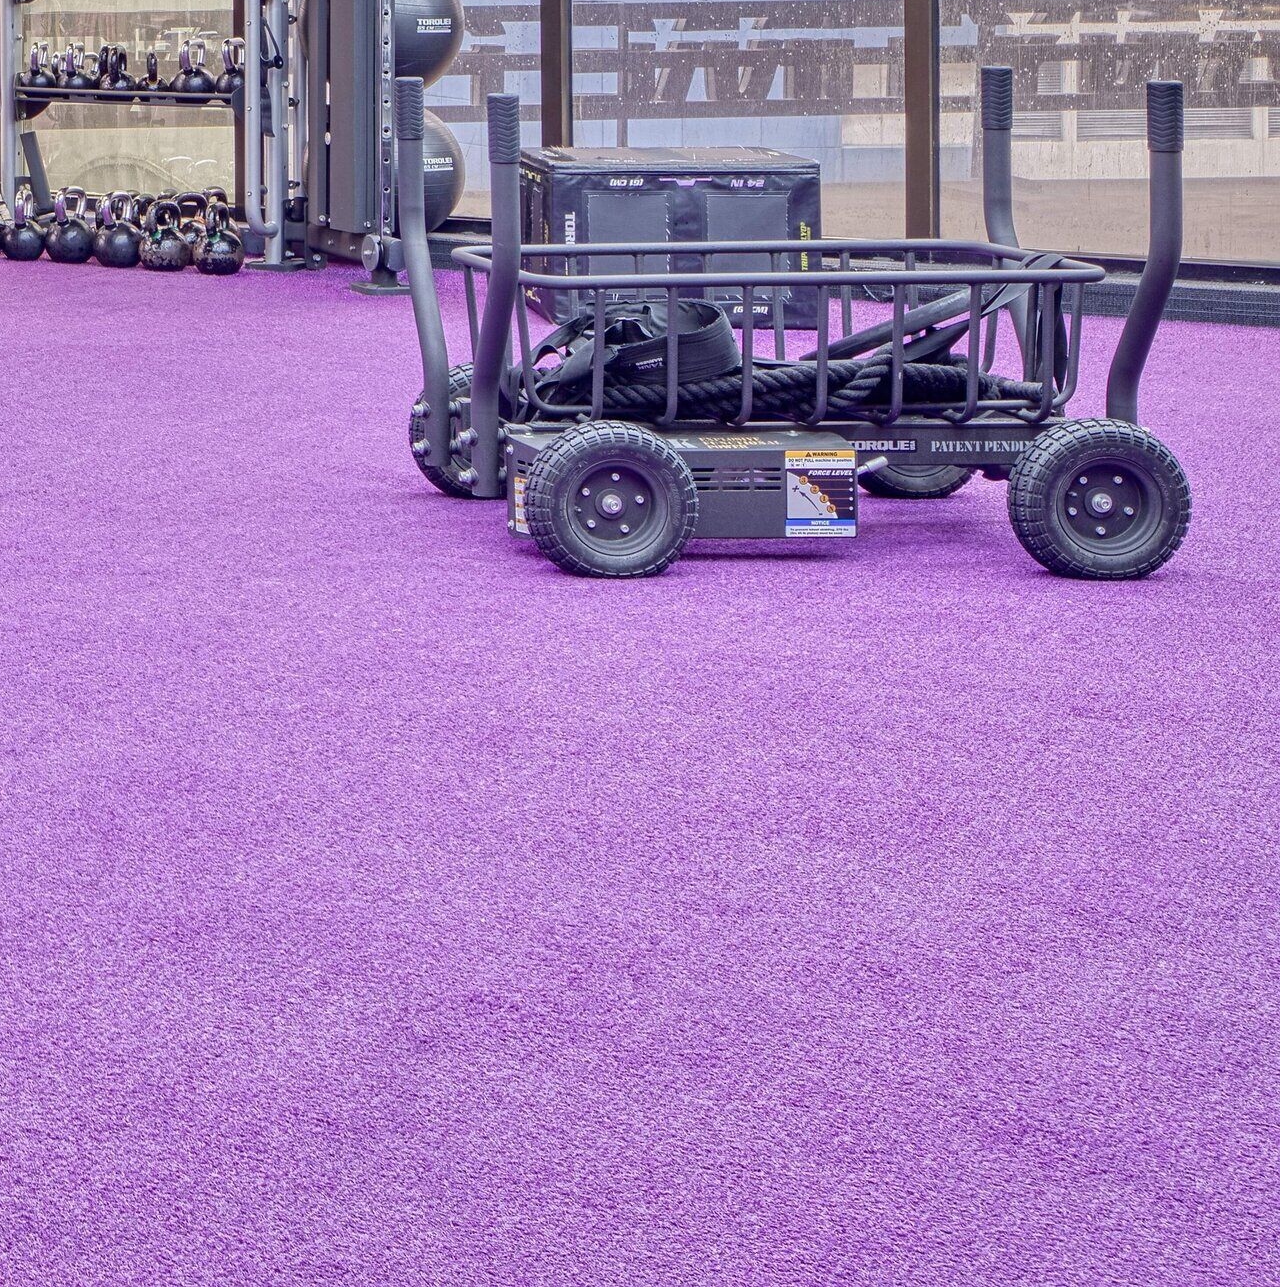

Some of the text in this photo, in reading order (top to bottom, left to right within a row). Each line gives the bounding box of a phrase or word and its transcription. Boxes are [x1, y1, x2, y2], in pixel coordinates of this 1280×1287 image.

[730, 179, 765, 188] 24 IN
[931, 440, 984, 453] PATENT
